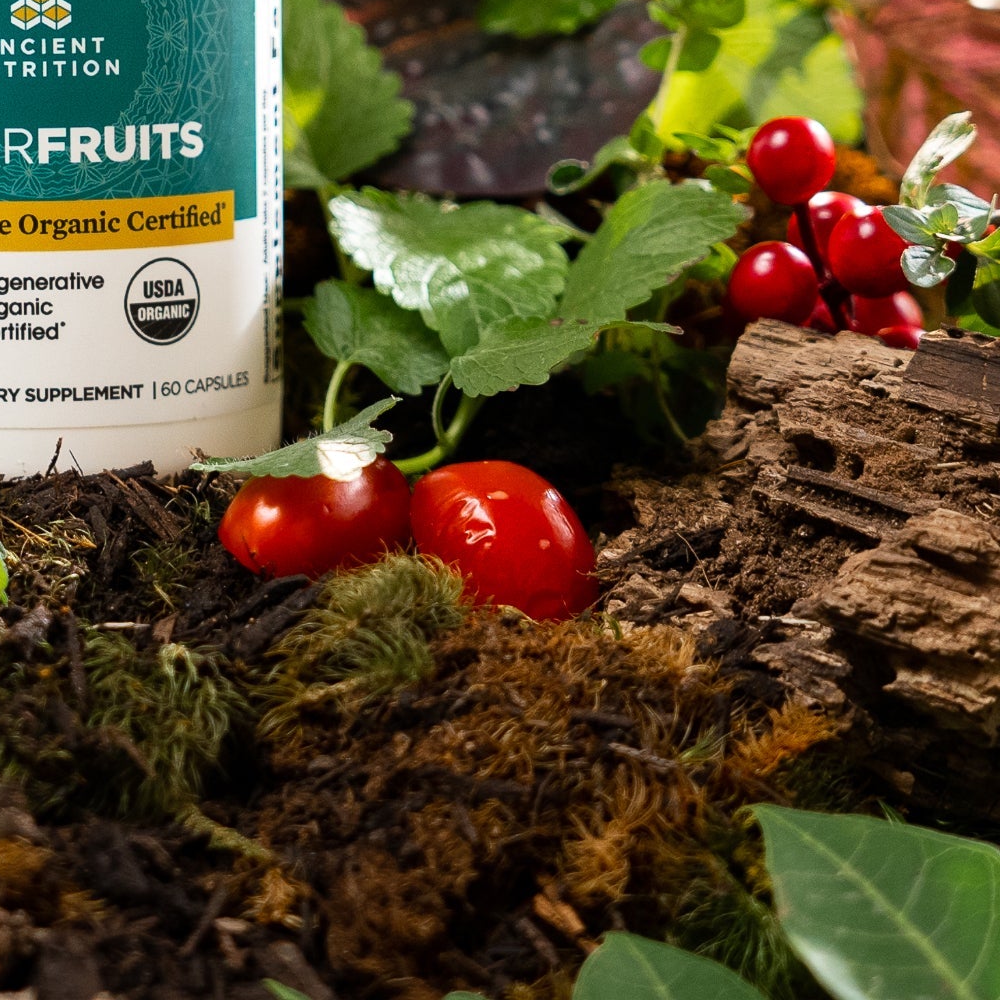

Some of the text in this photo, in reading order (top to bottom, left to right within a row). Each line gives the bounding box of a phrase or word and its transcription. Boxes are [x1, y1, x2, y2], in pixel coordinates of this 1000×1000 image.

[18, 210, 121, 241] Organic
[143, 278, 185, 299] USDA
[137, 304, 190, 322] ORGANIC
[24, 383, 144, 403] SUPPLEMENT
[160, 379, 181, 397] 60
[184, 370, 250, 395] CAPSULES
